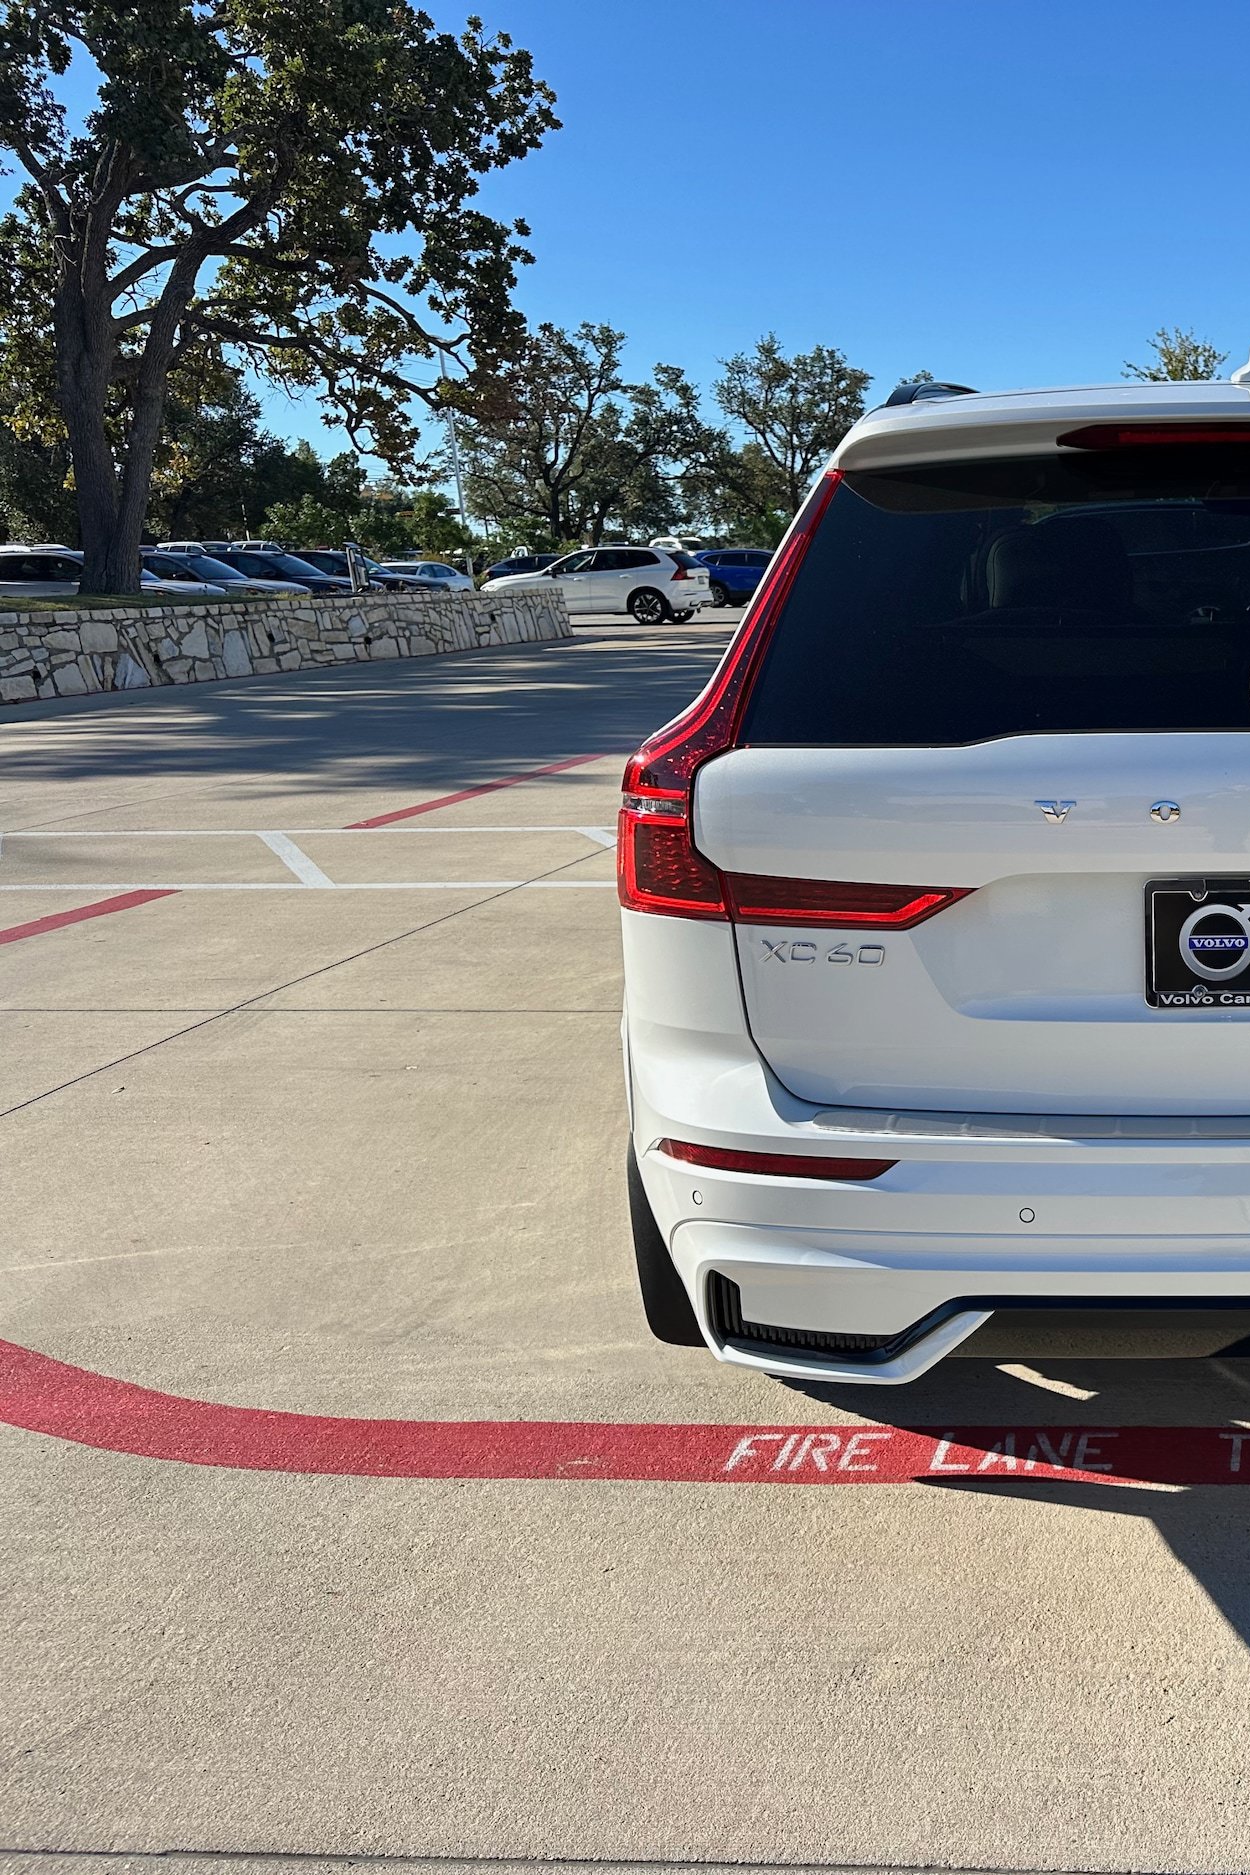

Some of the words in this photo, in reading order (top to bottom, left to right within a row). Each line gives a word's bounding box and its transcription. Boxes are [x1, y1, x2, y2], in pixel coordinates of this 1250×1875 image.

[1191, 938, 1246, 948] VOLVO
[1160, 993, 1214, 1005] Volvo
[724, 1433, 892, 1472] FIRE
[930, 1433, 1120, 1472] LANE
